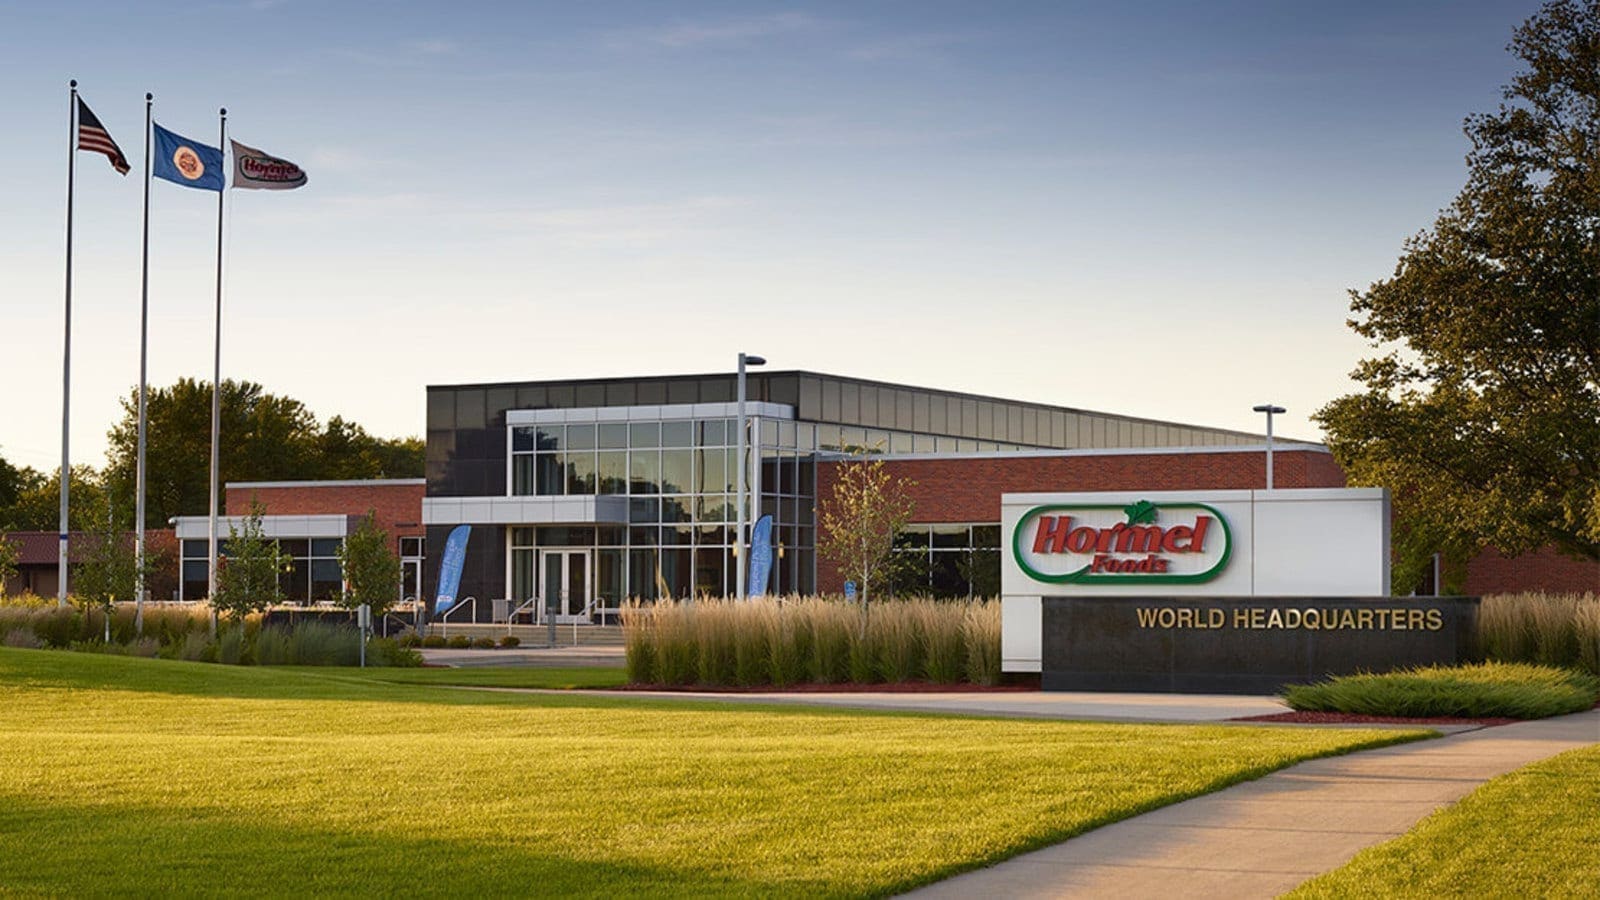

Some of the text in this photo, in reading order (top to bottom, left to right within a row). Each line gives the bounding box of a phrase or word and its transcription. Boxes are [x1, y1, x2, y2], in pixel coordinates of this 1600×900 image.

[1032, 515, 1209, 553] Hormel
[1090, 554, 1169, 574] Foods
[1136, 607, 1443, 631] WORLD HEADQUARTERS
